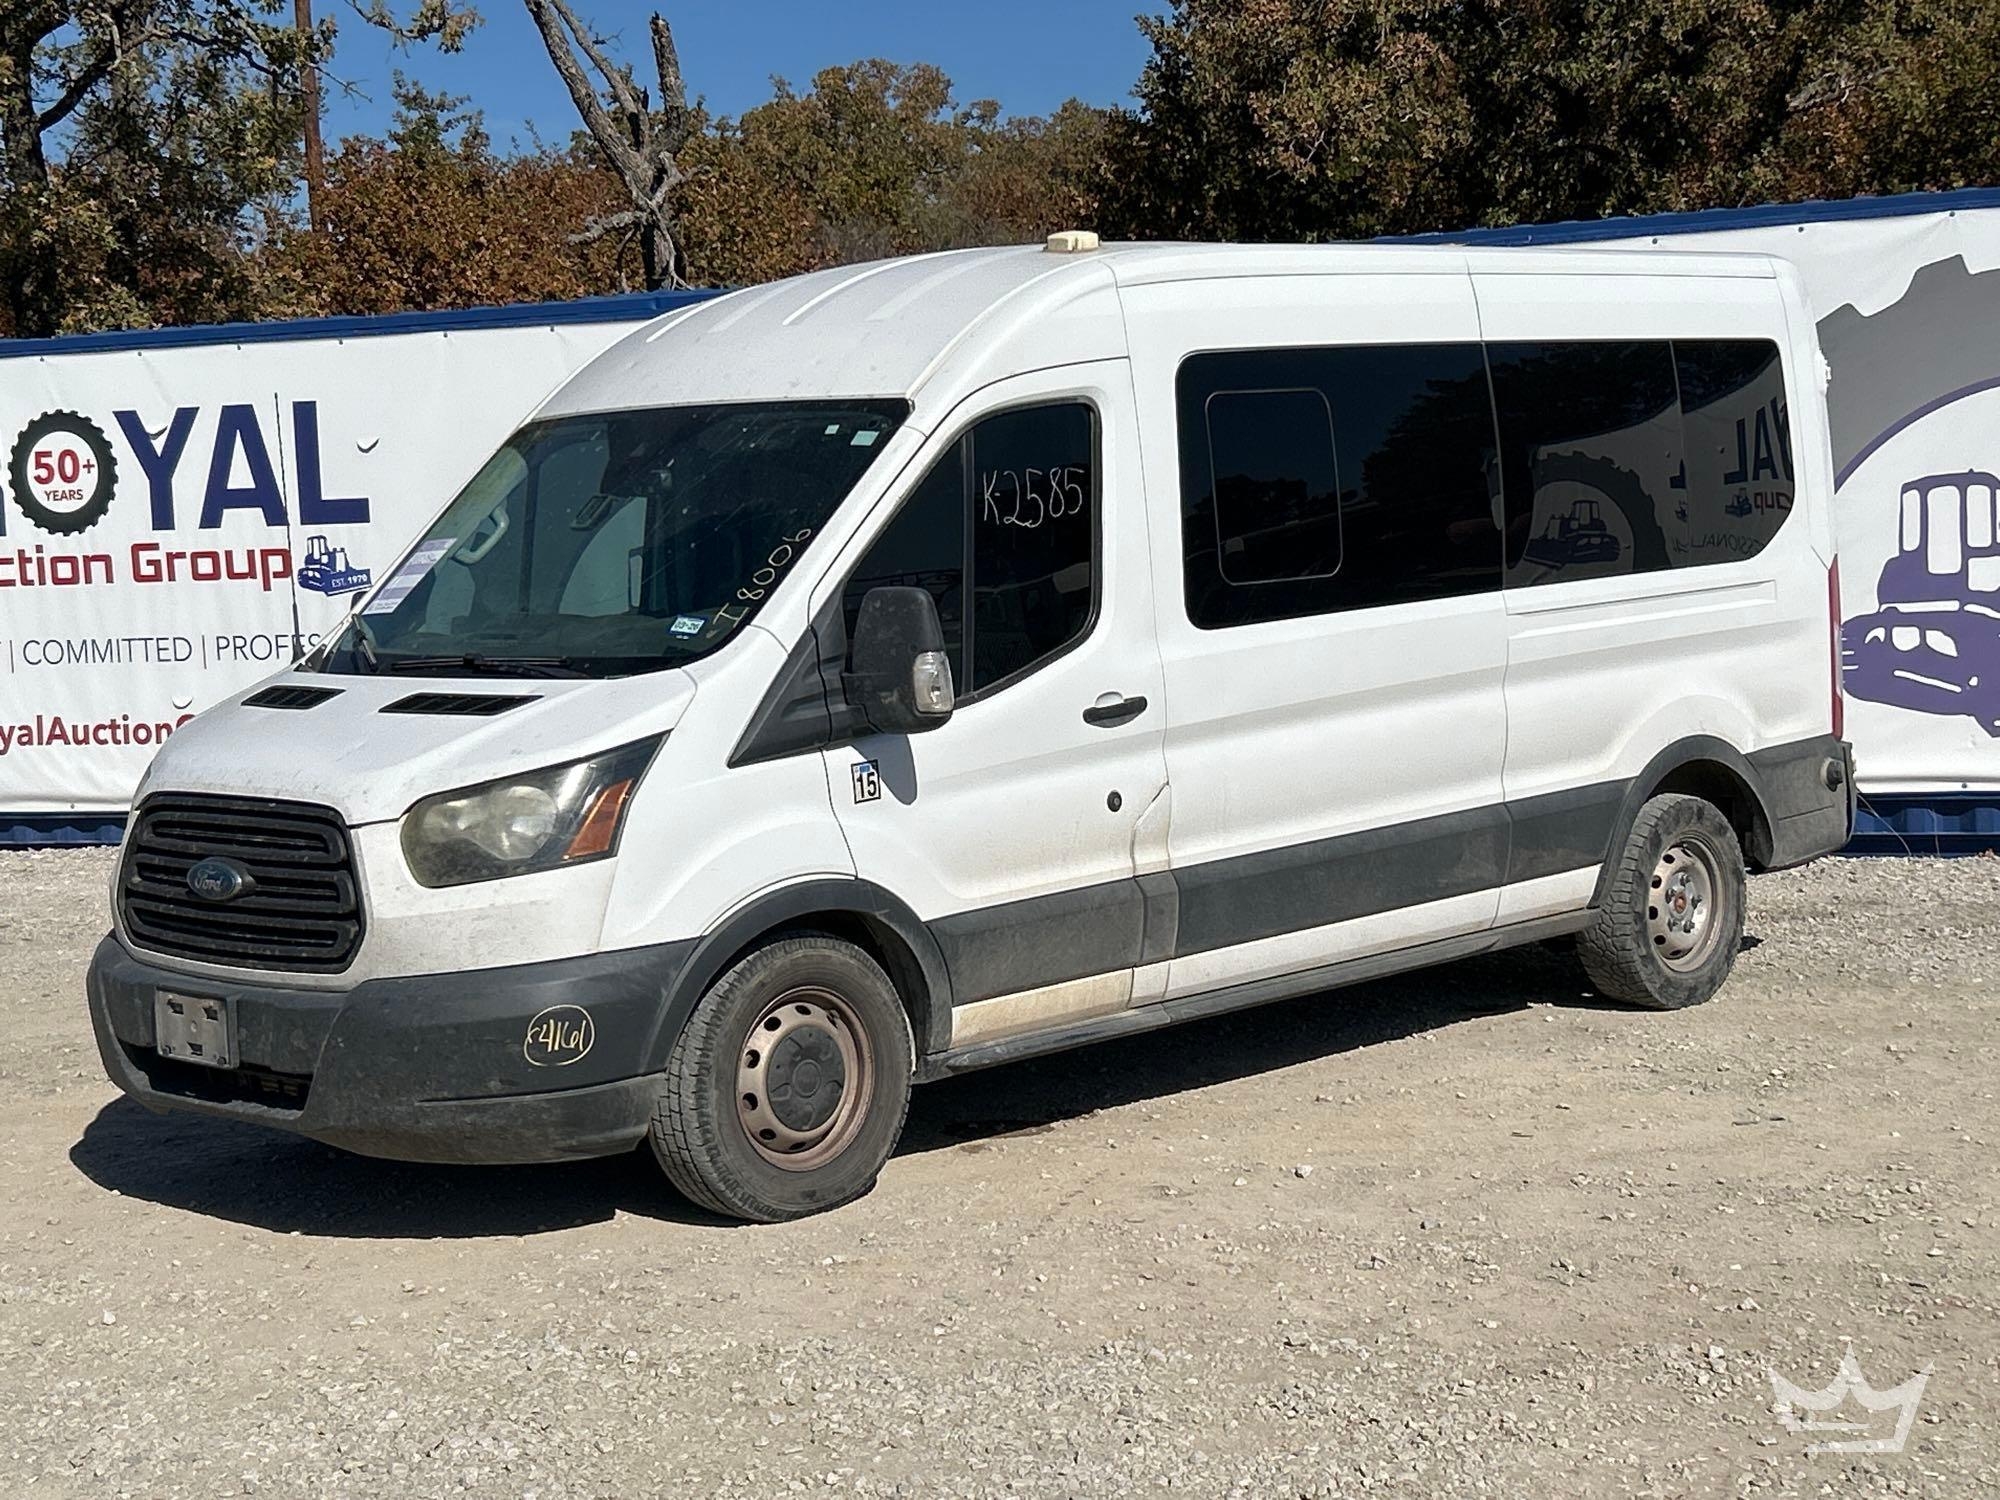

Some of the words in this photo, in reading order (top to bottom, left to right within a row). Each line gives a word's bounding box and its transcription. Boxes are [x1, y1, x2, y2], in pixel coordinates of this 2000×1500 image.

[0, 400, 371, 536] OYAL
[33, 448, 96, 485] 50+
[44, 488, 84, 502] YEARS
[131, 542, 292, 592] Group
[347, 573, 368, 585] 1970
[23, 636, 193, 666] COMMITTED
[0, 713, 196, 756] yalAuction
[856, 771, 877, 798] 15
